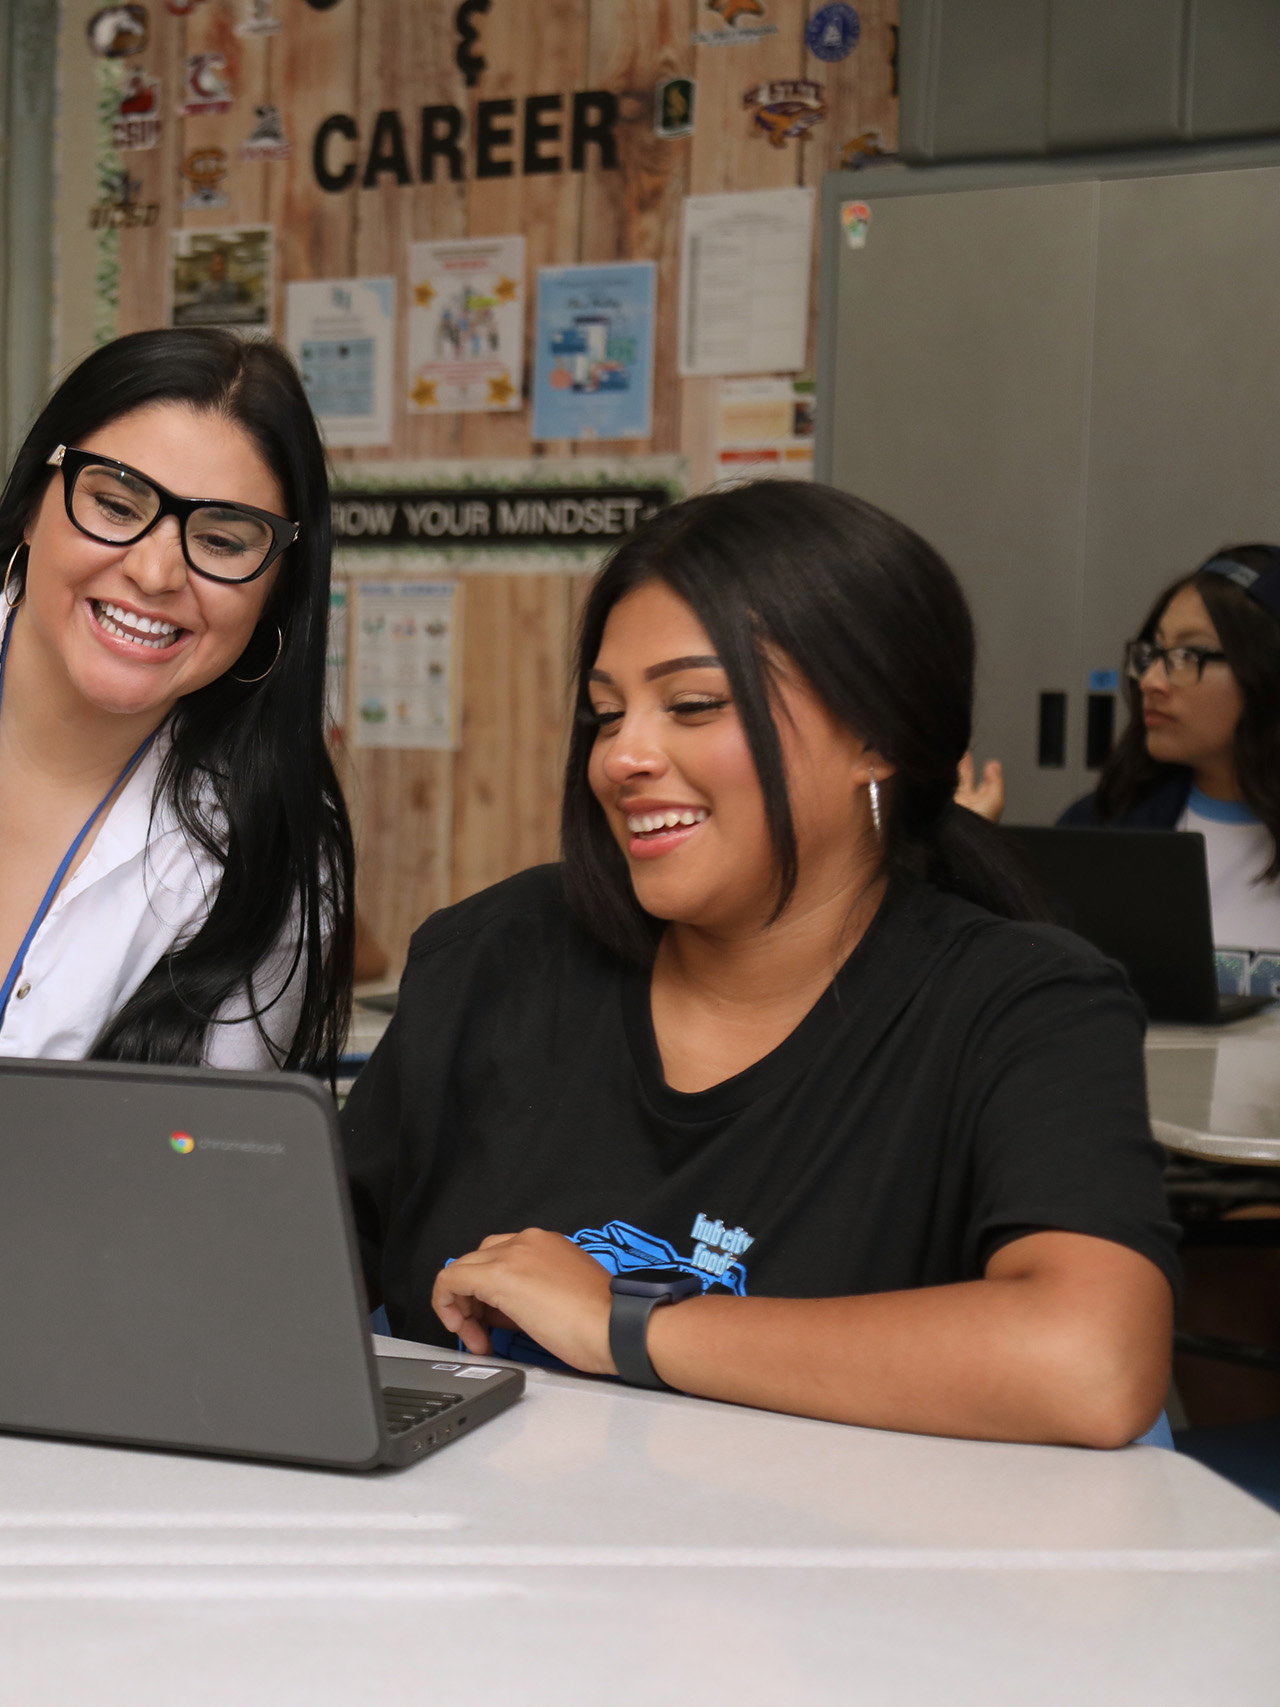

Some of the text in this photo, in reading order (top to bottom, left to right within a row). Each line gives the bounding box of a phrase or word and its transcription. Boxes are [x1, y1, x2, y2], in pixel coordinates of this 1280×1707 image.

[313, 90, 620, 193] CAREER
[400, 500, 491, 537] YOUR
[496, 498, 642, 536] MINDSET
[690, 1212, 756, 1256] hub city
